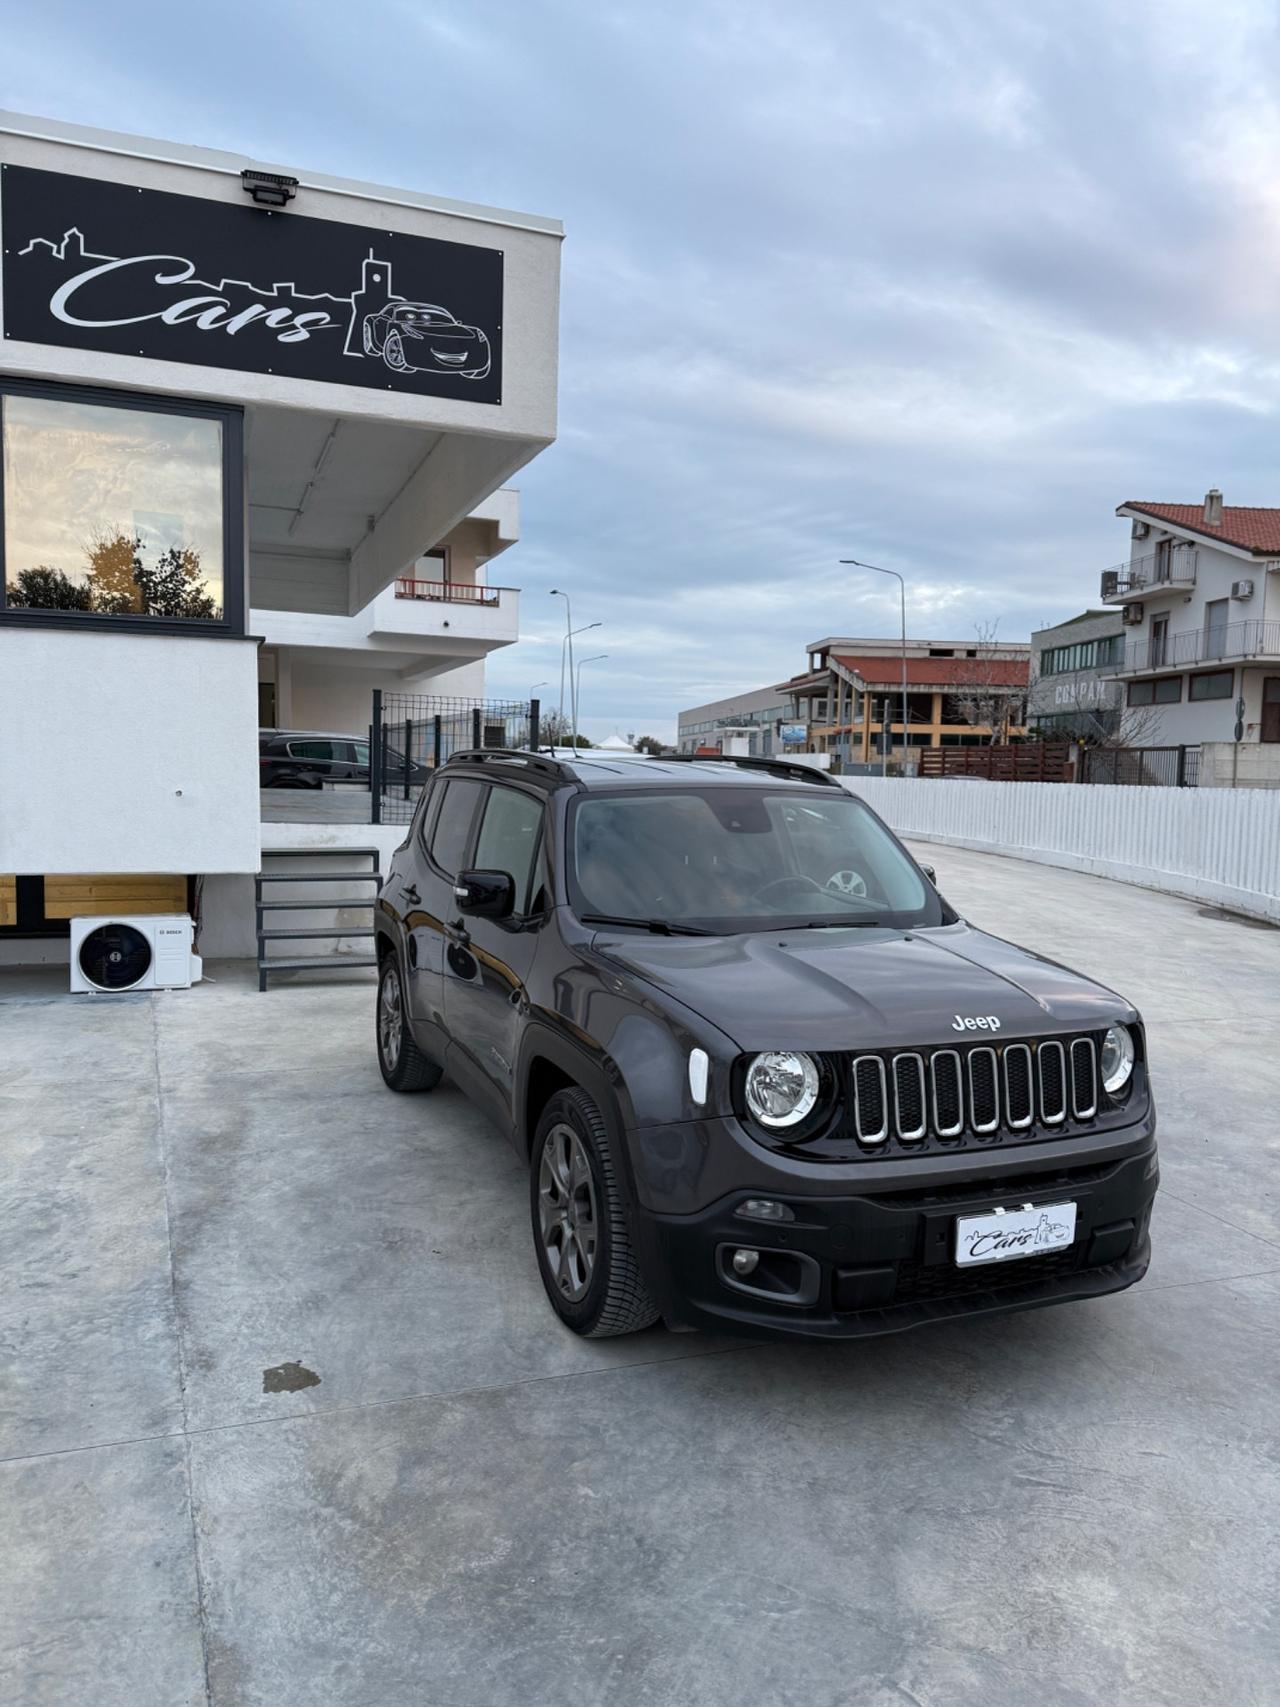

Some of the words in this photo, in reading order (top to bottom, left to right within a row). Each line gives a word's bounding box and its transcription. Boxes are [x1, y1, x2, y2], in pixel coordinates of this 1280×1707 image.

[50, 255, 342, 342] Cars
[951, 1014, 1001, 1032] Jeep
[969, 1230, 1033, 1257] Cars
